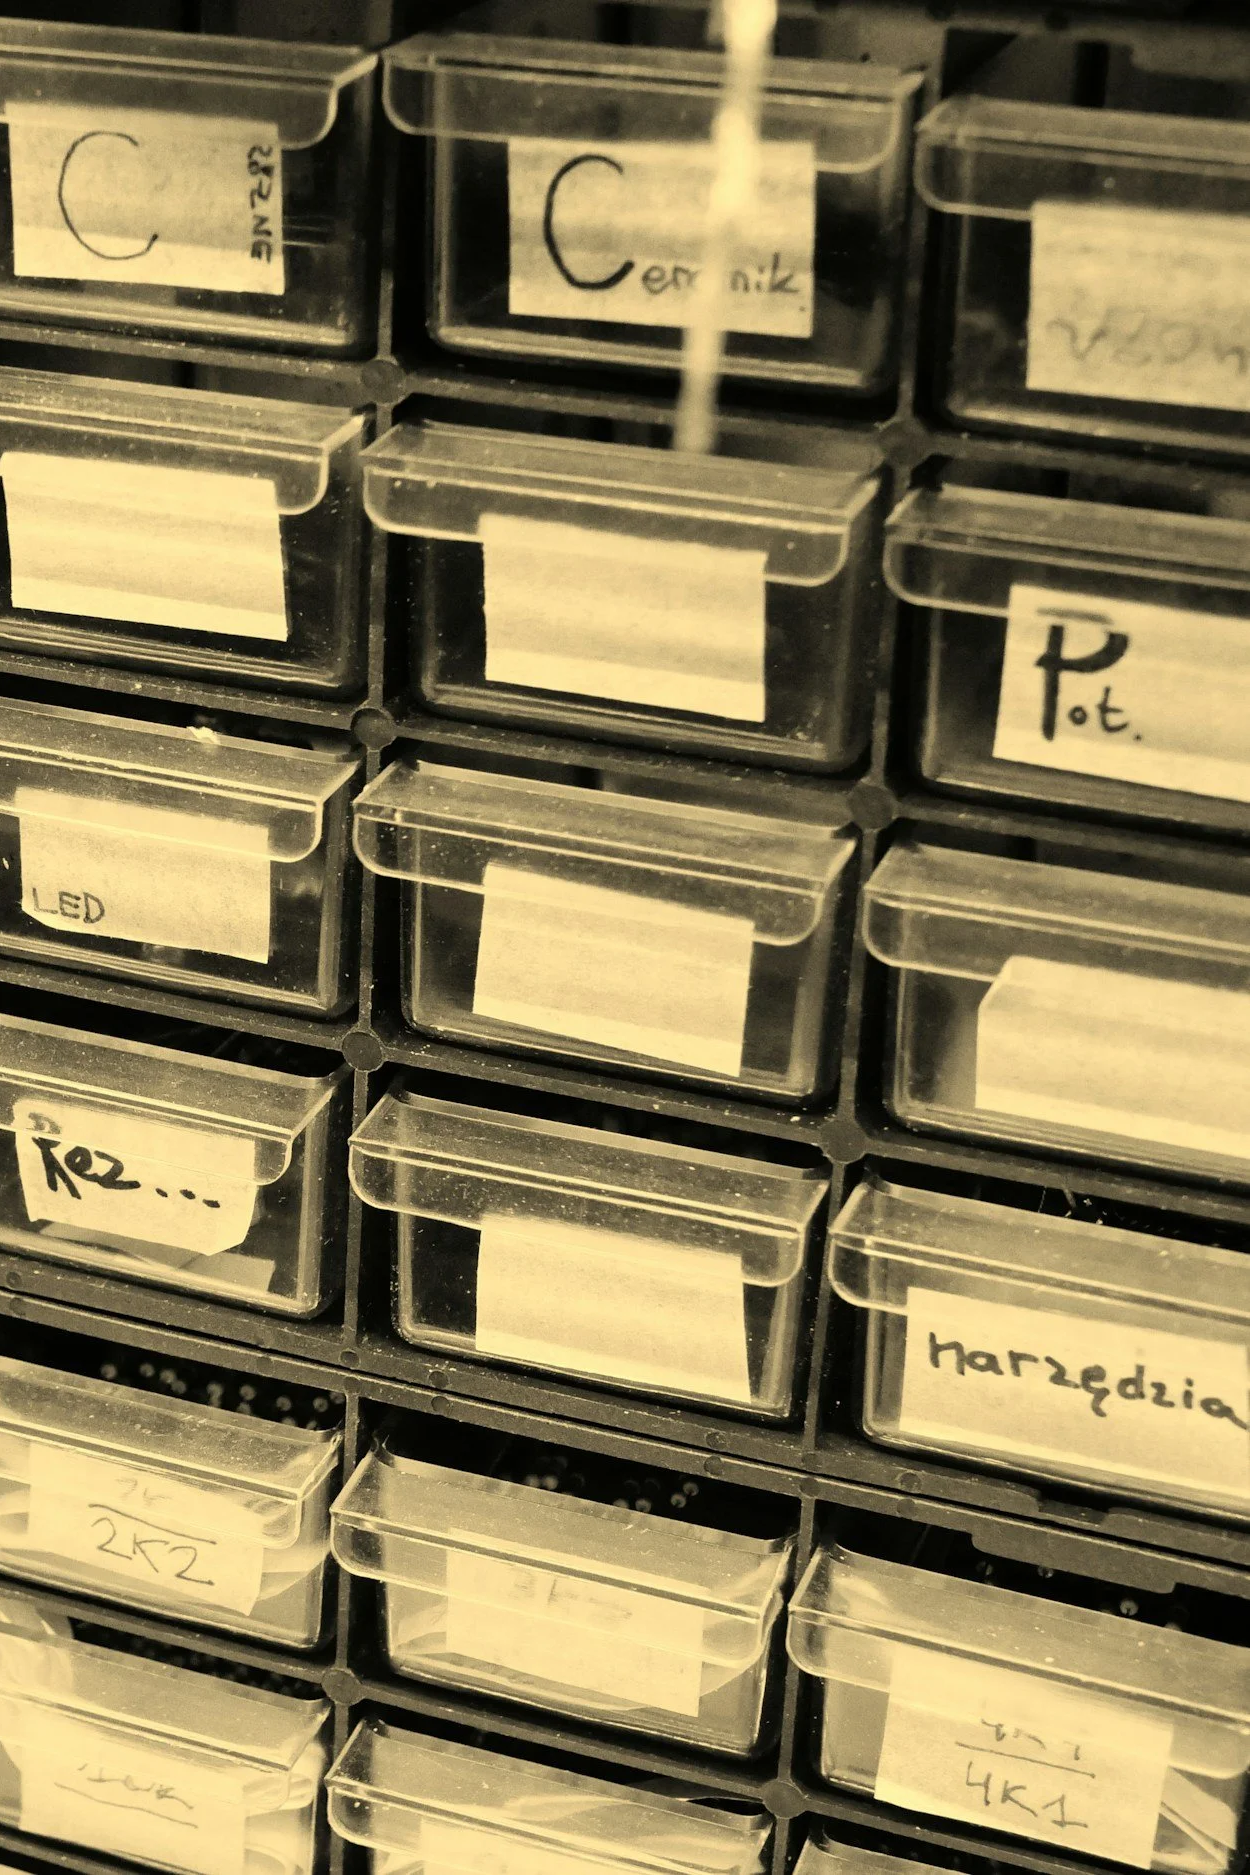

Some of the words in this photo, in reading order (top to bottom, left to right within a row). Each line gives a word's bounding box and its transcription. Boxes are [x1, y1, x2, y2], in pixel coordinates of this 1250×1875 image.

[58, 131, 159, 260] C
[31, 886, 106, 924] LED
[929, 1331, 1248, 1430] narzędzia
[91, 1516, 216, 1586] 2K2
[966, 1761, 1088, 1828] 4K1
